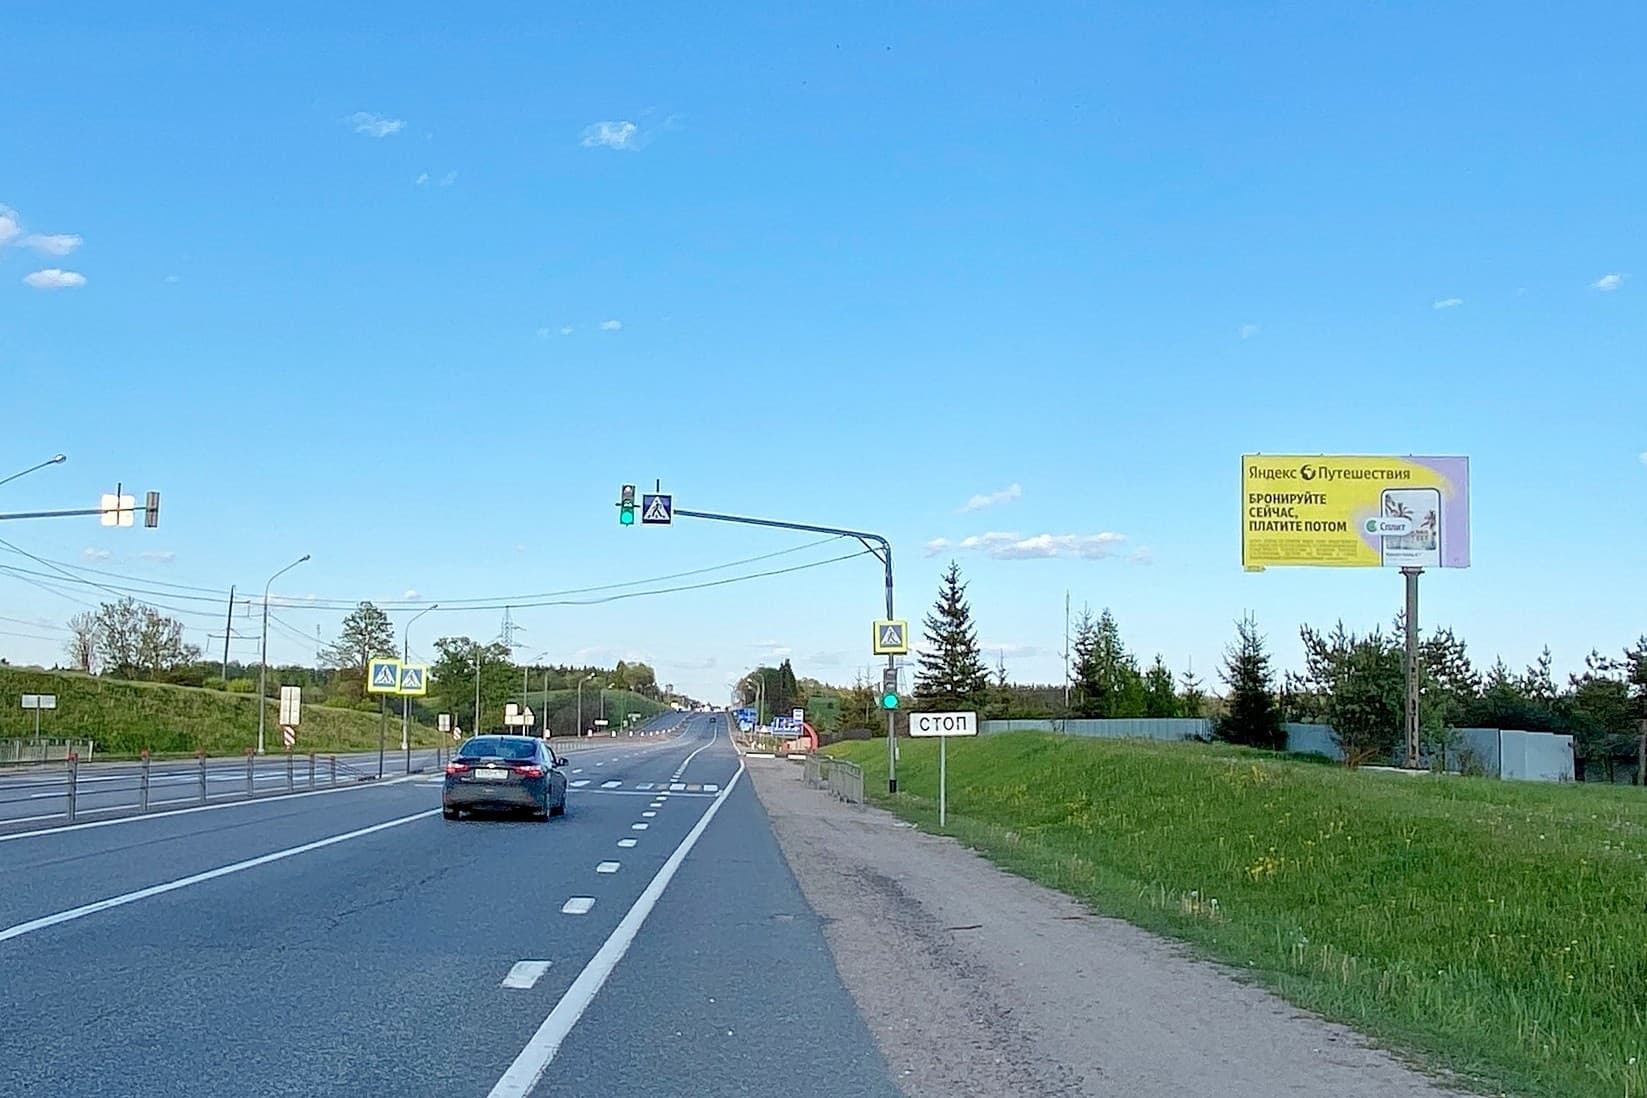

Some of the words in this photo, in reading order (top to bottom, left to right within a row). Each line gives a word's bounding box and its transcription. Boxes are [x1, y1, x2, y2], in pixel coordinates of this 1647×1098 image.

[1249, 466, 1297, 481] Яндекс
[1318, 466, 1411, 481] Путешествия
[1249, 491, 1327, 505] БРОНИРУЙТЕ
[1249, 504, 1299, 519] СЕЙЧАС,
[1249, 520, 1303, 532] ПЛАТИТЕ
[1305, 520, 1347, 532] ПОТОМ
[920, 716, 967, 731] СТОП
